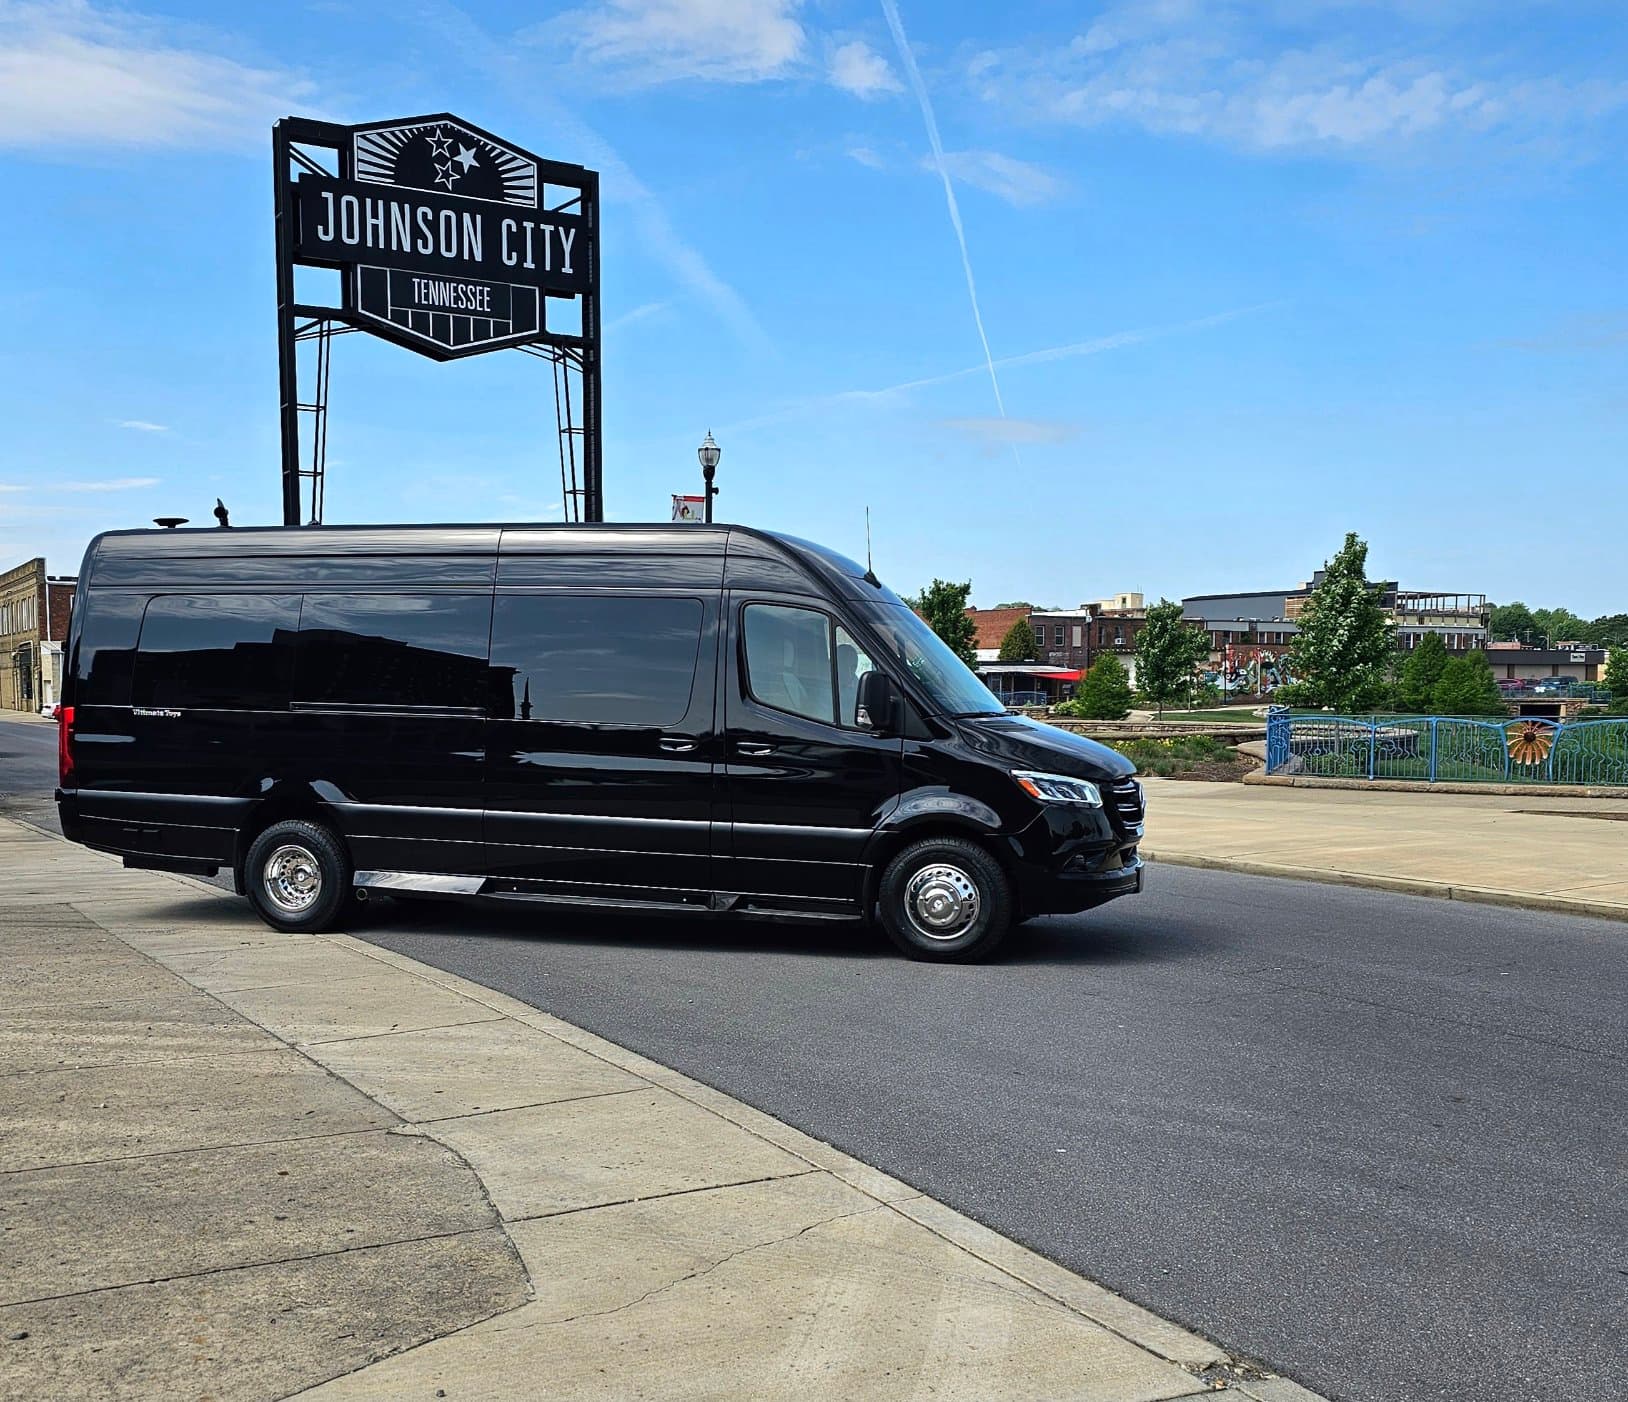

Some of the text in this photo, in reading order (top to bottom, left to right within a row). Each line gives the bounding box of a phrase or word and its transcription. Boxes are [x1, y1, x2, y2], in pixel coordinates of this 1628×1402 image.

[317, 191, 576, 274] JOHNSON CITY
[411, 278, 491, 312] TENNESSEE
